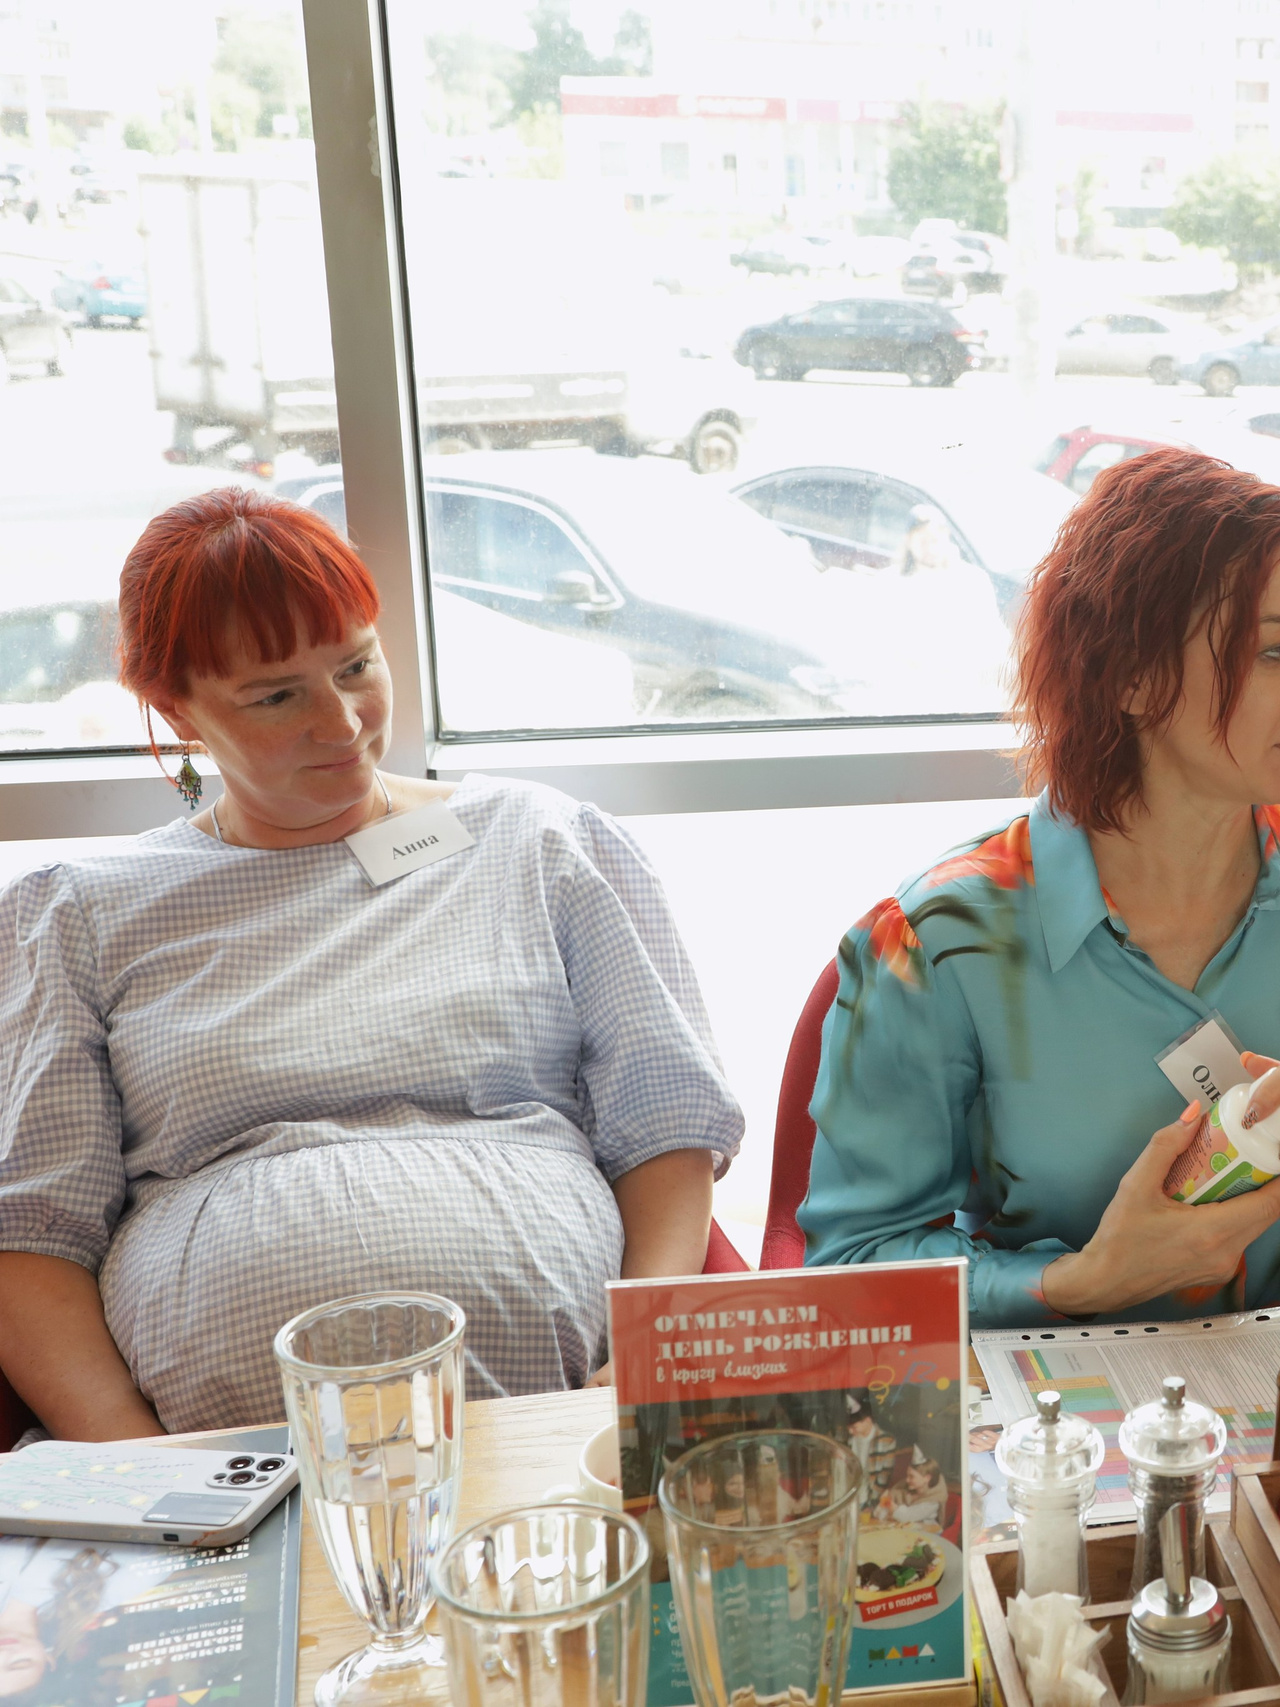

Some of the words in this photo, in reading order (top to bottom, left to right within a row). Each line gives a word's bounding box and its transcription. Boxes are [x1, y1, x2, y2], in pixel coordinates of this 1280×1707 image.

[391, 834, 440, 860] Анна
[654, 1305, 818, 1333] ОТМЕЧАЕМ
[655, 1338, 735, 1363] ДЕНЬ
[744, 1325, 912, 1353] РОЖДЕНИЯ
[656, 1366, 665, 1383] в
[673, 1366, 716, 1384] кругу
[723, 1361, 788, 1380] близких
[866, 1603, 886, 1615] ТОРТ
[888, 1601, 895, 1610] В
[895, 1592, 934, 1607] ПОДАРОК
[139, 1632, 243, 1659] БОЛЬШИХ
[170, 1642, 243, 1663] КОМБО
